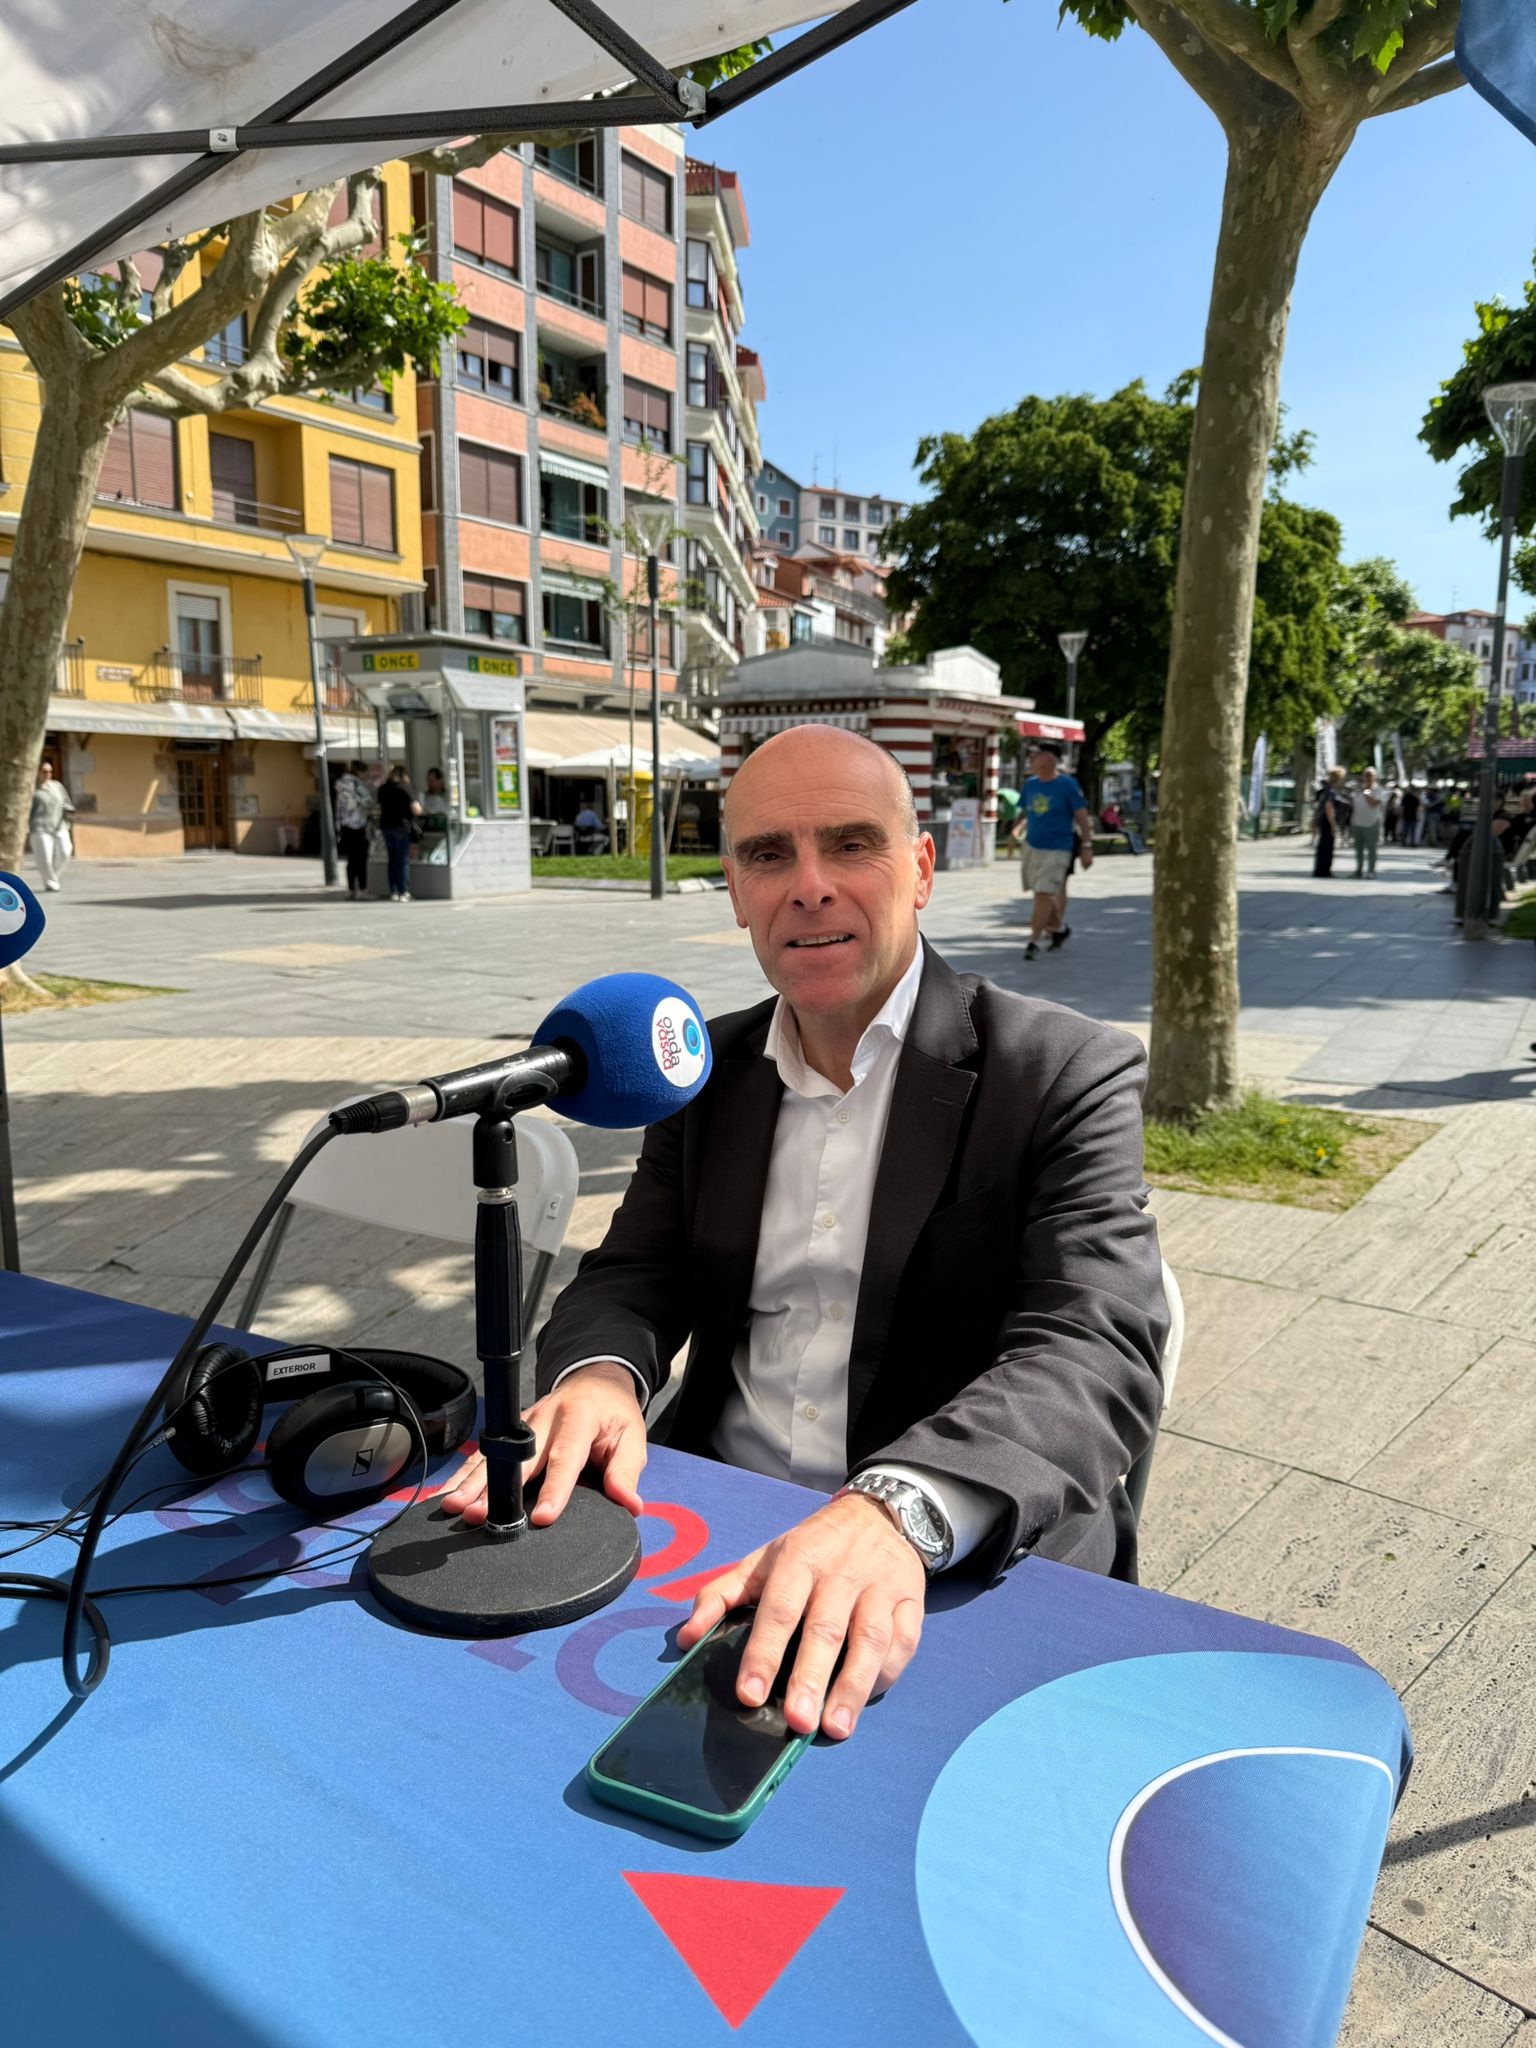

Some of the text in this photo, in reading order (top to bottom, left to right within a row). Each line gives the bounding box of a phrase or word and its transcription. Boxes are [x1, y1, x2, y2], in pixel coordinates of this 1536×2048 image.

[379, 655, 416, 669] ONCE
[483, 659, 516, 676] ONCE
[656, 1019, 673, 1070] vasca
[663, 1016, 681, 1069] onda
[273, 1363, 316, 1376] EXTERIOR
